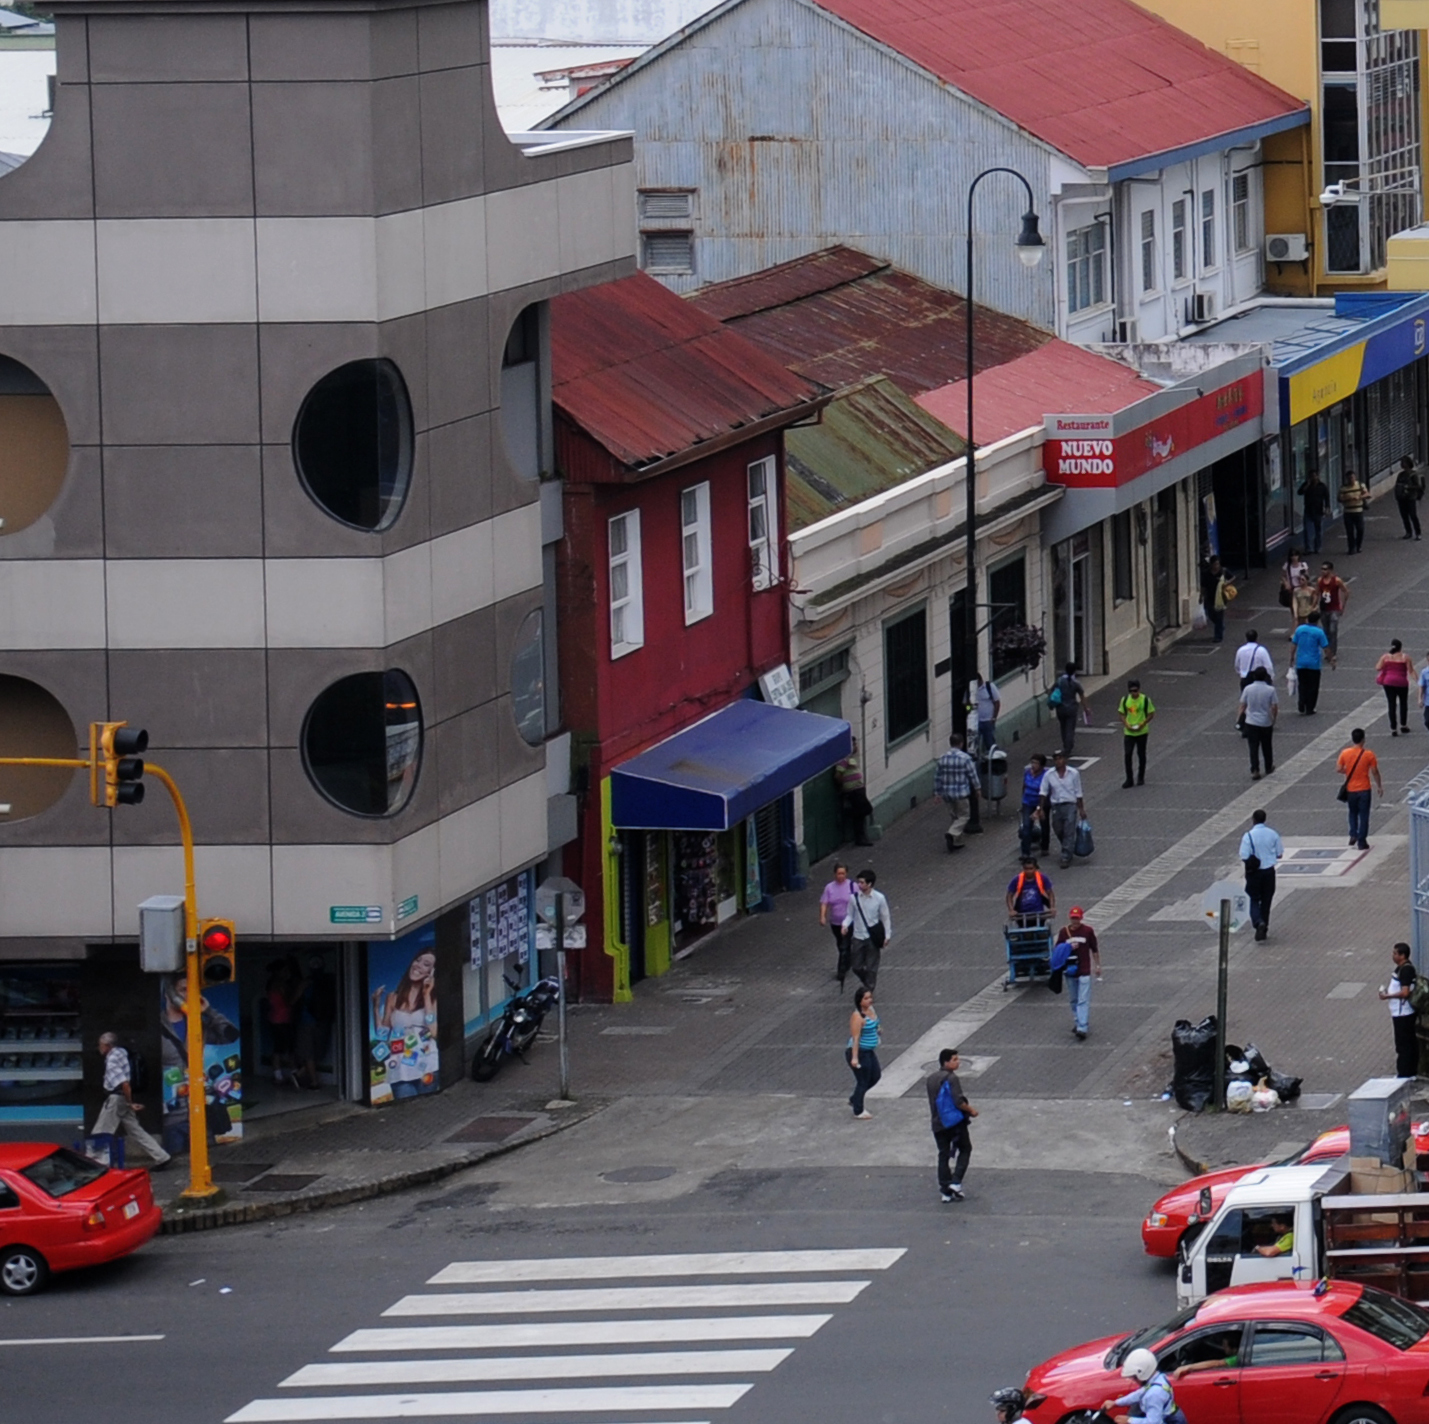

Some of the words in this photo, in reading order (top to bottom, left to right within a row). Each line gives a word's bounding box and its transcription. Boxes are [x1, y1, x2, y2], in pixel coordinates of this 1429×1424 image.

[1056, 419, 1110, 430] Restaurante
[1060, 440, 1113, 456] NUEVO
[1058, 458, 1114, 474] MUNDO
